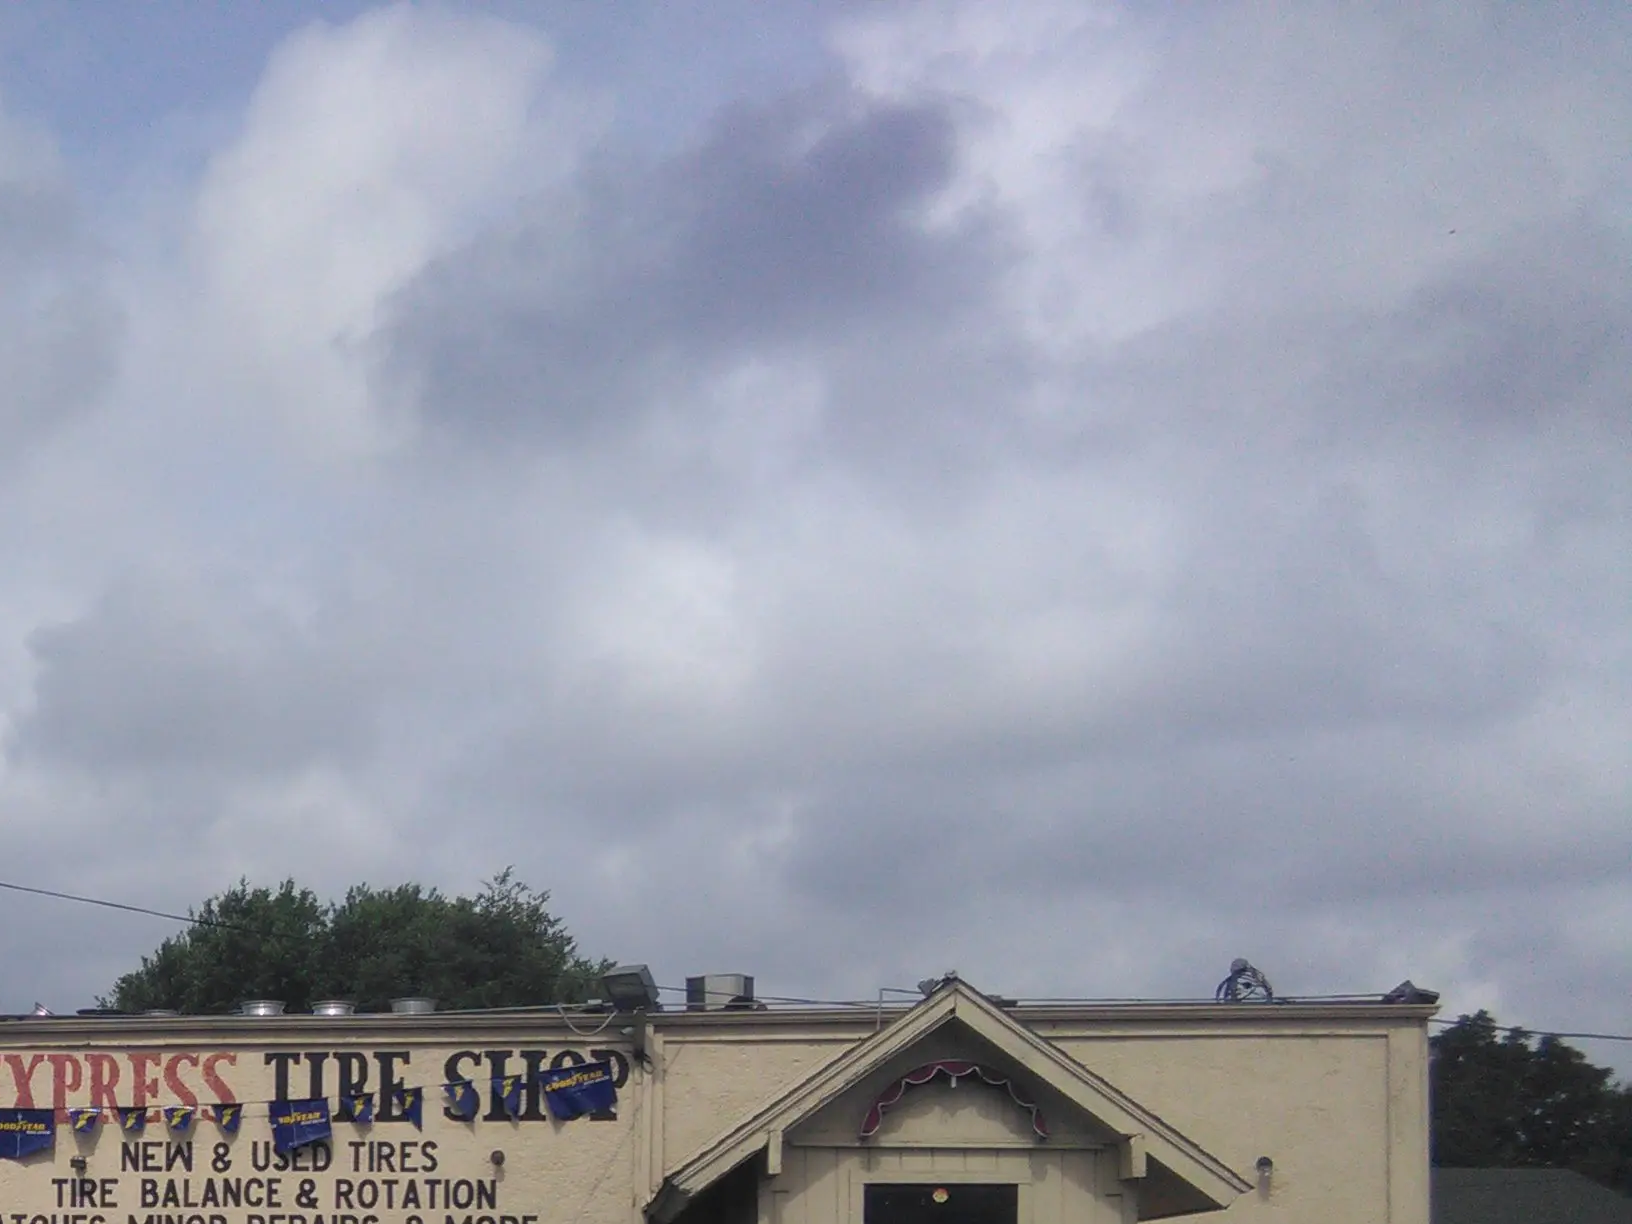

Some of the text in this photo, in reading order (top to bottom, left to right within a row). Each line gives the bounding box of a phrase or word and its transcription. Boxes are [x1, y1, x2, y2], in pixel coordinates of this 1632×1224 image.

[264, 1051, 411, 1122] TIRE
[121, 1140, 438, 1173] NEW & USED TIRES
[52, 1177, 498, 1210] TIRE BALANCE & ROTATION
